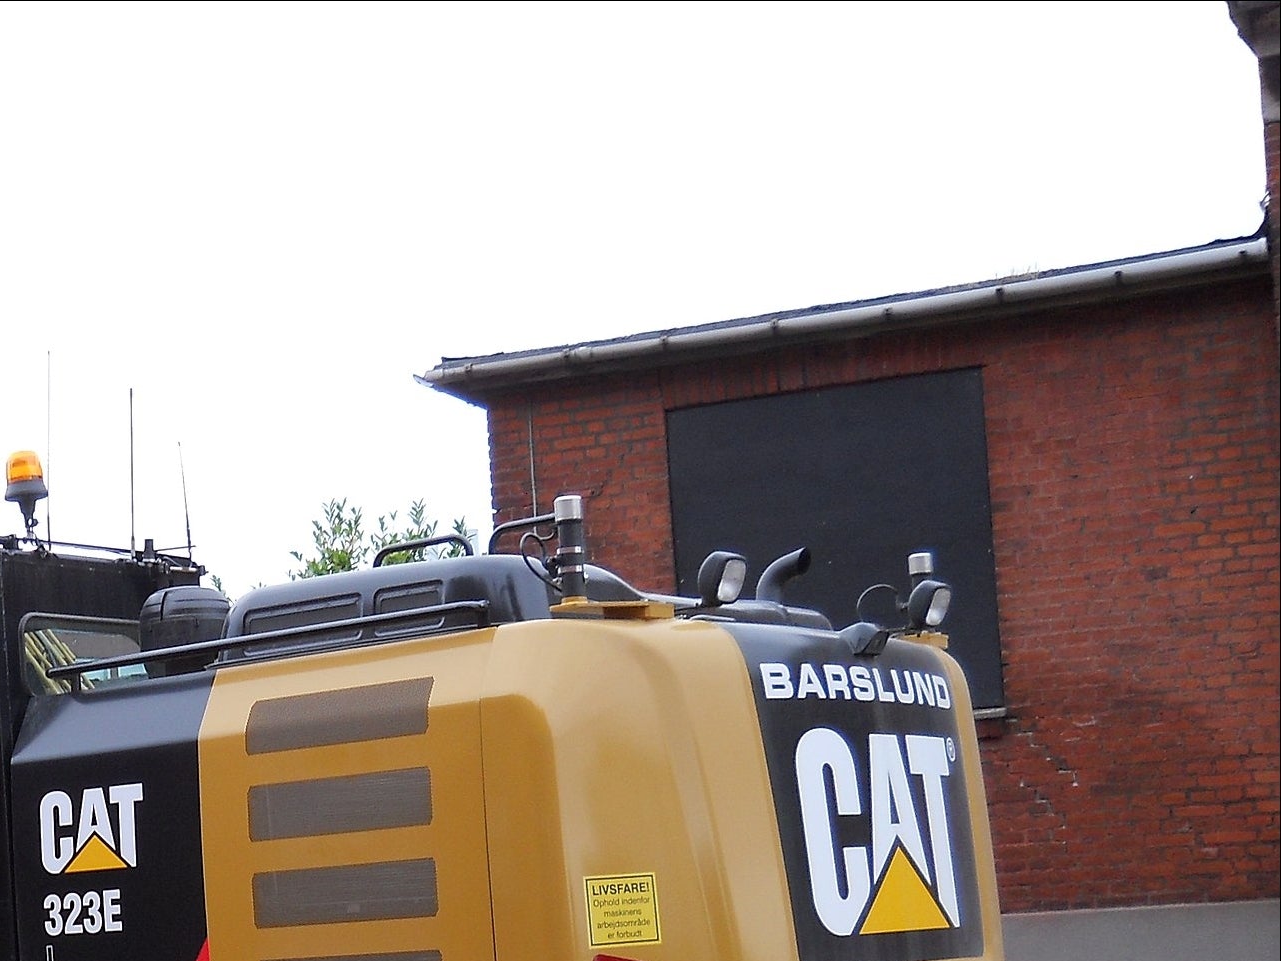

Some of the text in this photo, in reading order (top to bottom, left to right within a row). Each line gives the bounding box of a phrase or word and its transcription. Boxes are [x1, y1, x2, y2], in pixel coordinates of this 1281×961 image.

[760, 663, 951, 709] BARSLUND
[40, 783, 144, 875] CAT
[796, 727, 960, 936] CAT
[592, 882, 650, 896] LIVSFARE!
[593, 898, 620, 909] Ophold
[44, 889, 123, 936] 323E
